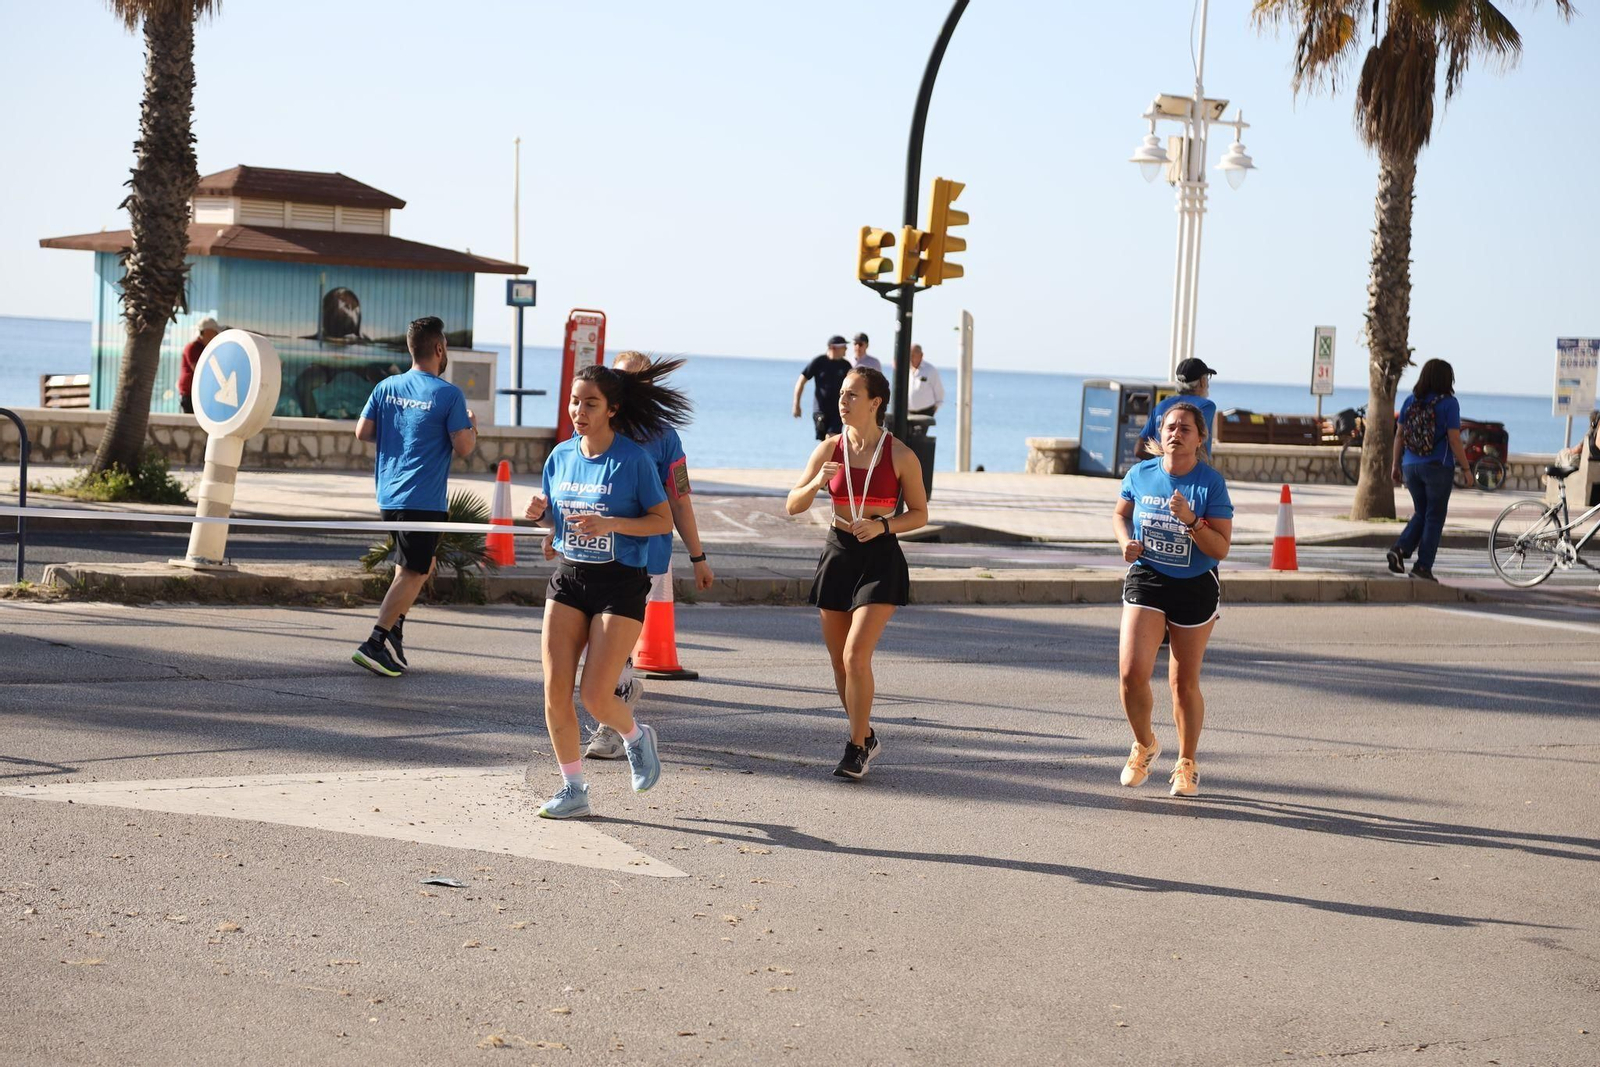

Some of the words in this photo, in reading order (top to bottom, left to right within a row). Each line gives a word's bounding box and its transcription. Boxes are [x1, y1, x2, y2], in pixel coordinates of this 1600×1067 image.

[385, 395, 432, 411] mayoral
[559, 482, 612, 495] mayoral
[1141, 495, 1195, 511] mayl
[568, 534, 608, 549] 2026
[1147, 538, 1184, 555] 1889
